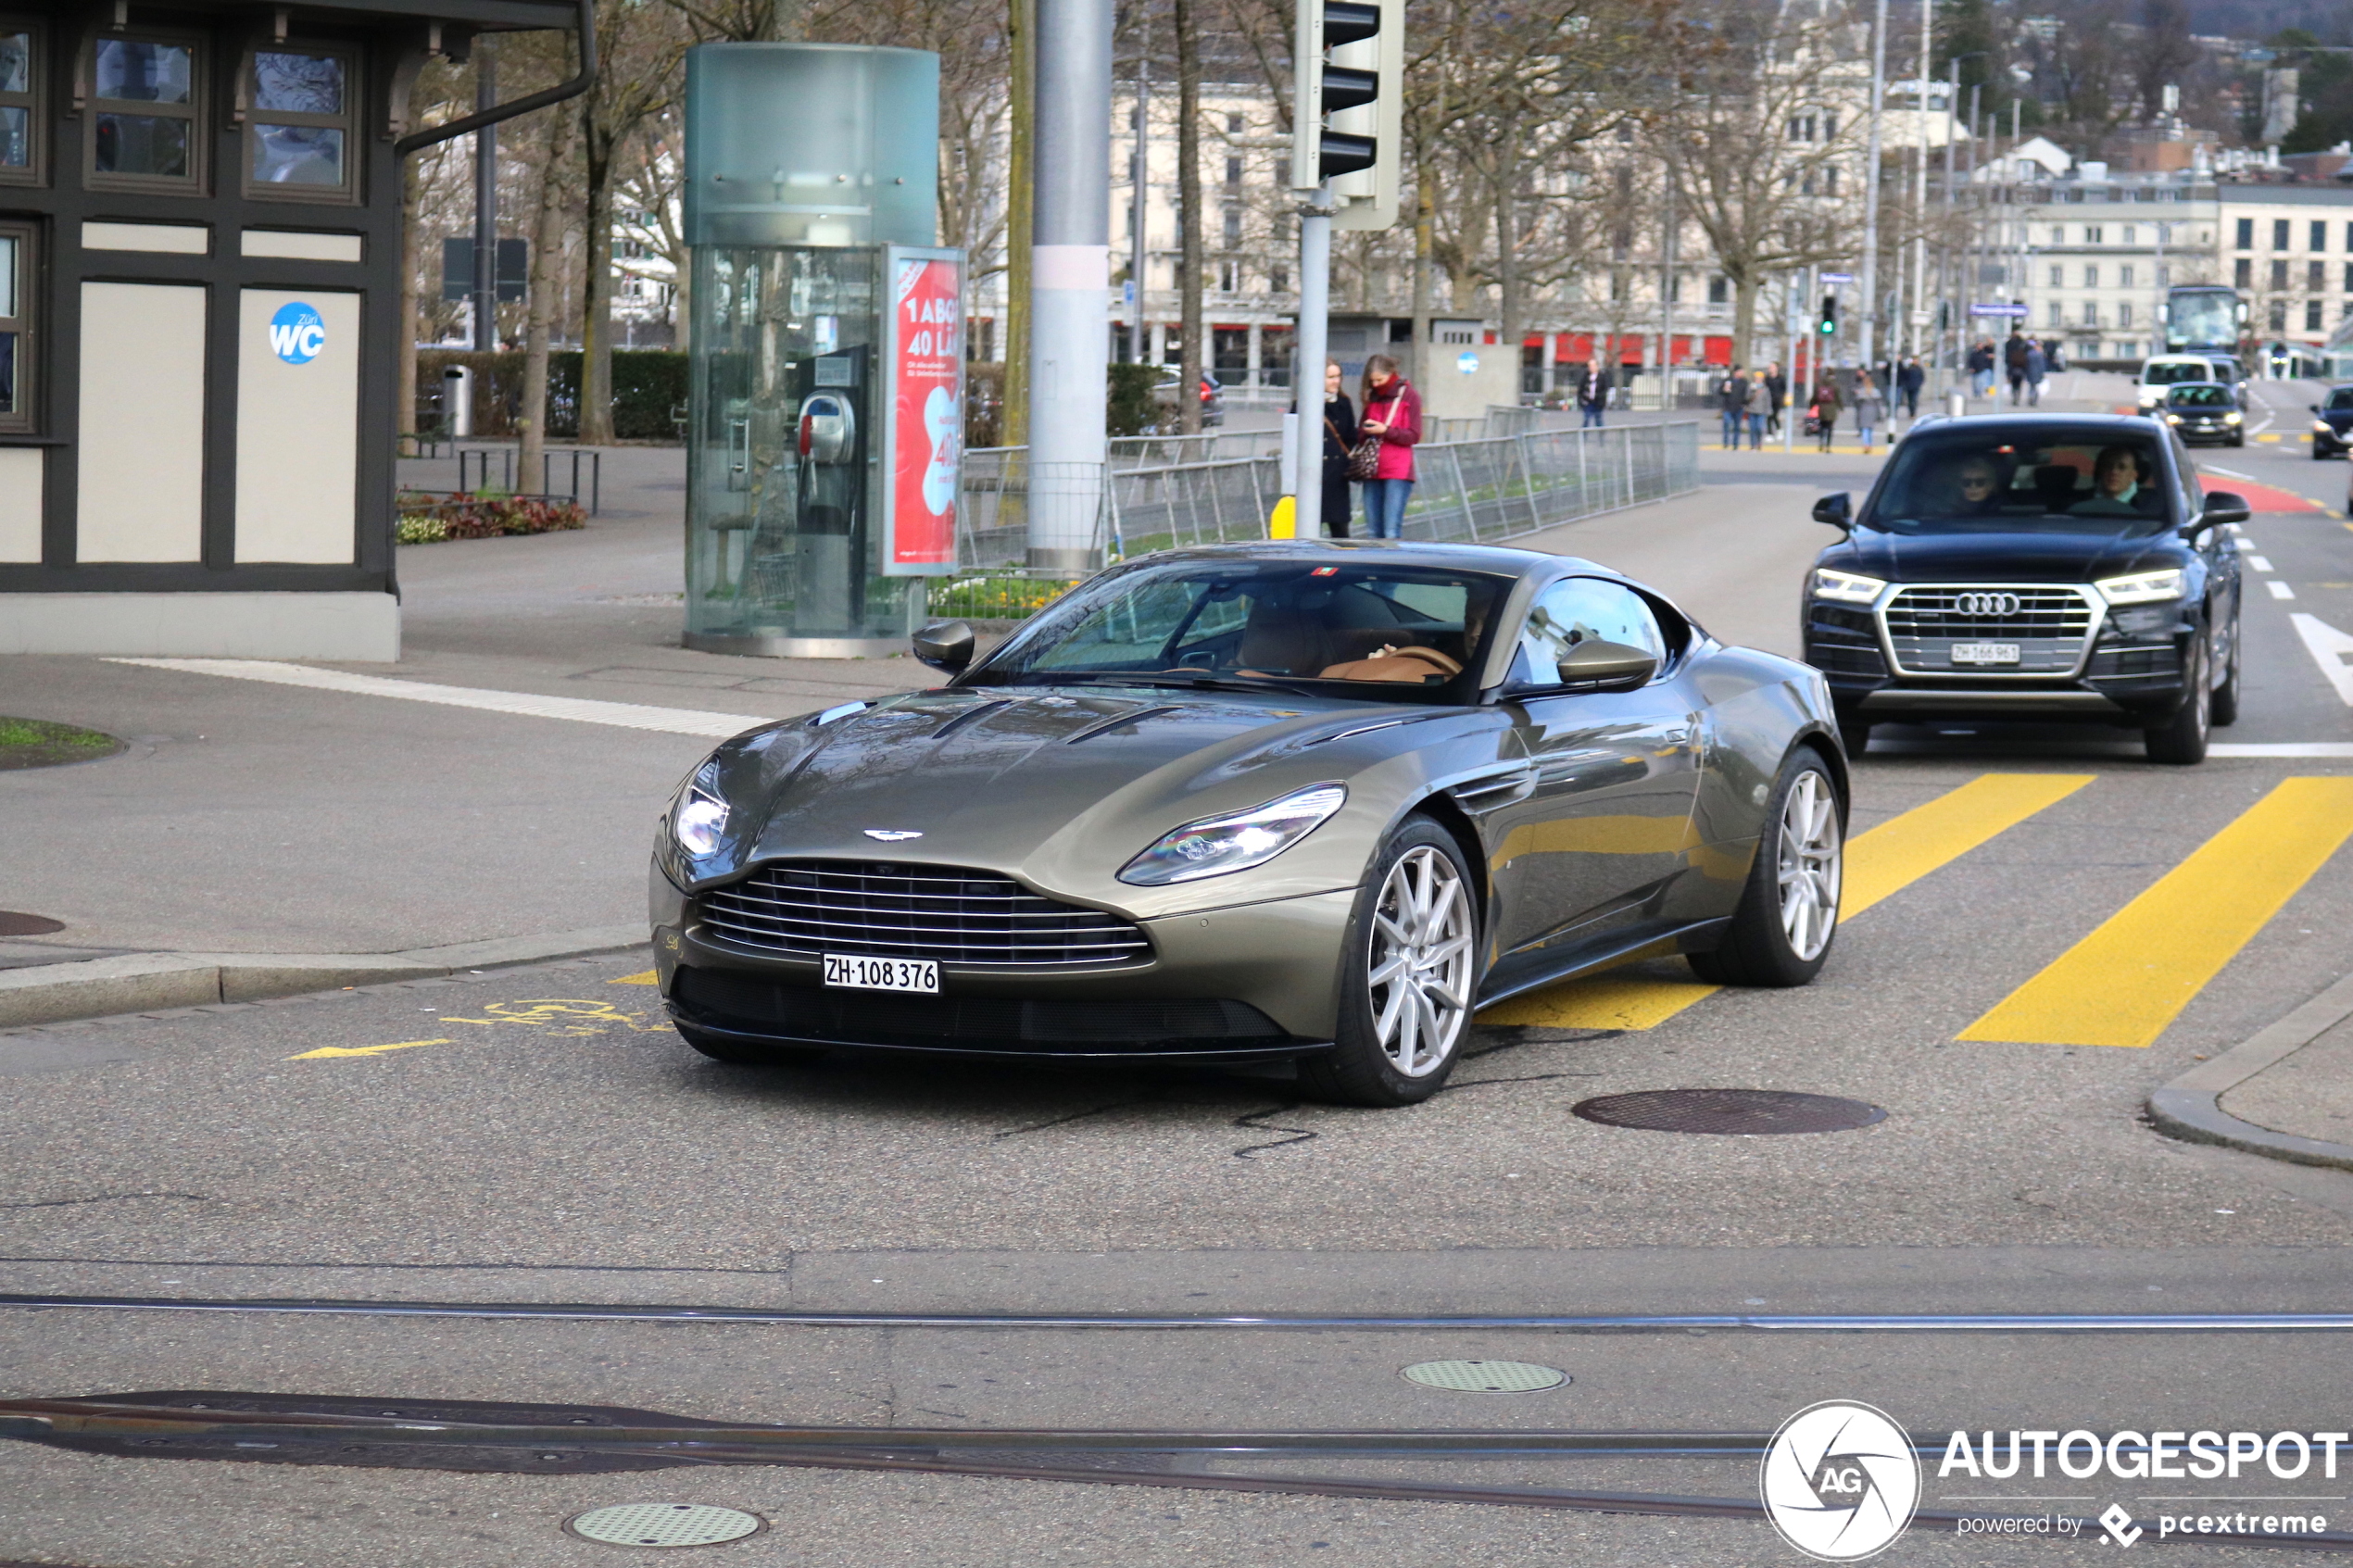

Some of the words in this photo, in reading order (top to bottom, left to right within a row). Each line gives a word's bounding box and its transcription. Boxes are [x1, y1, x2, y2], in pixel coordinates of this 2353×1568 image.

[905, 297, 917, 322] 1
[270, 324, 325, 357] WC
[907, 330, 932, 357] 40
[899, 962, 936, 989] 376
